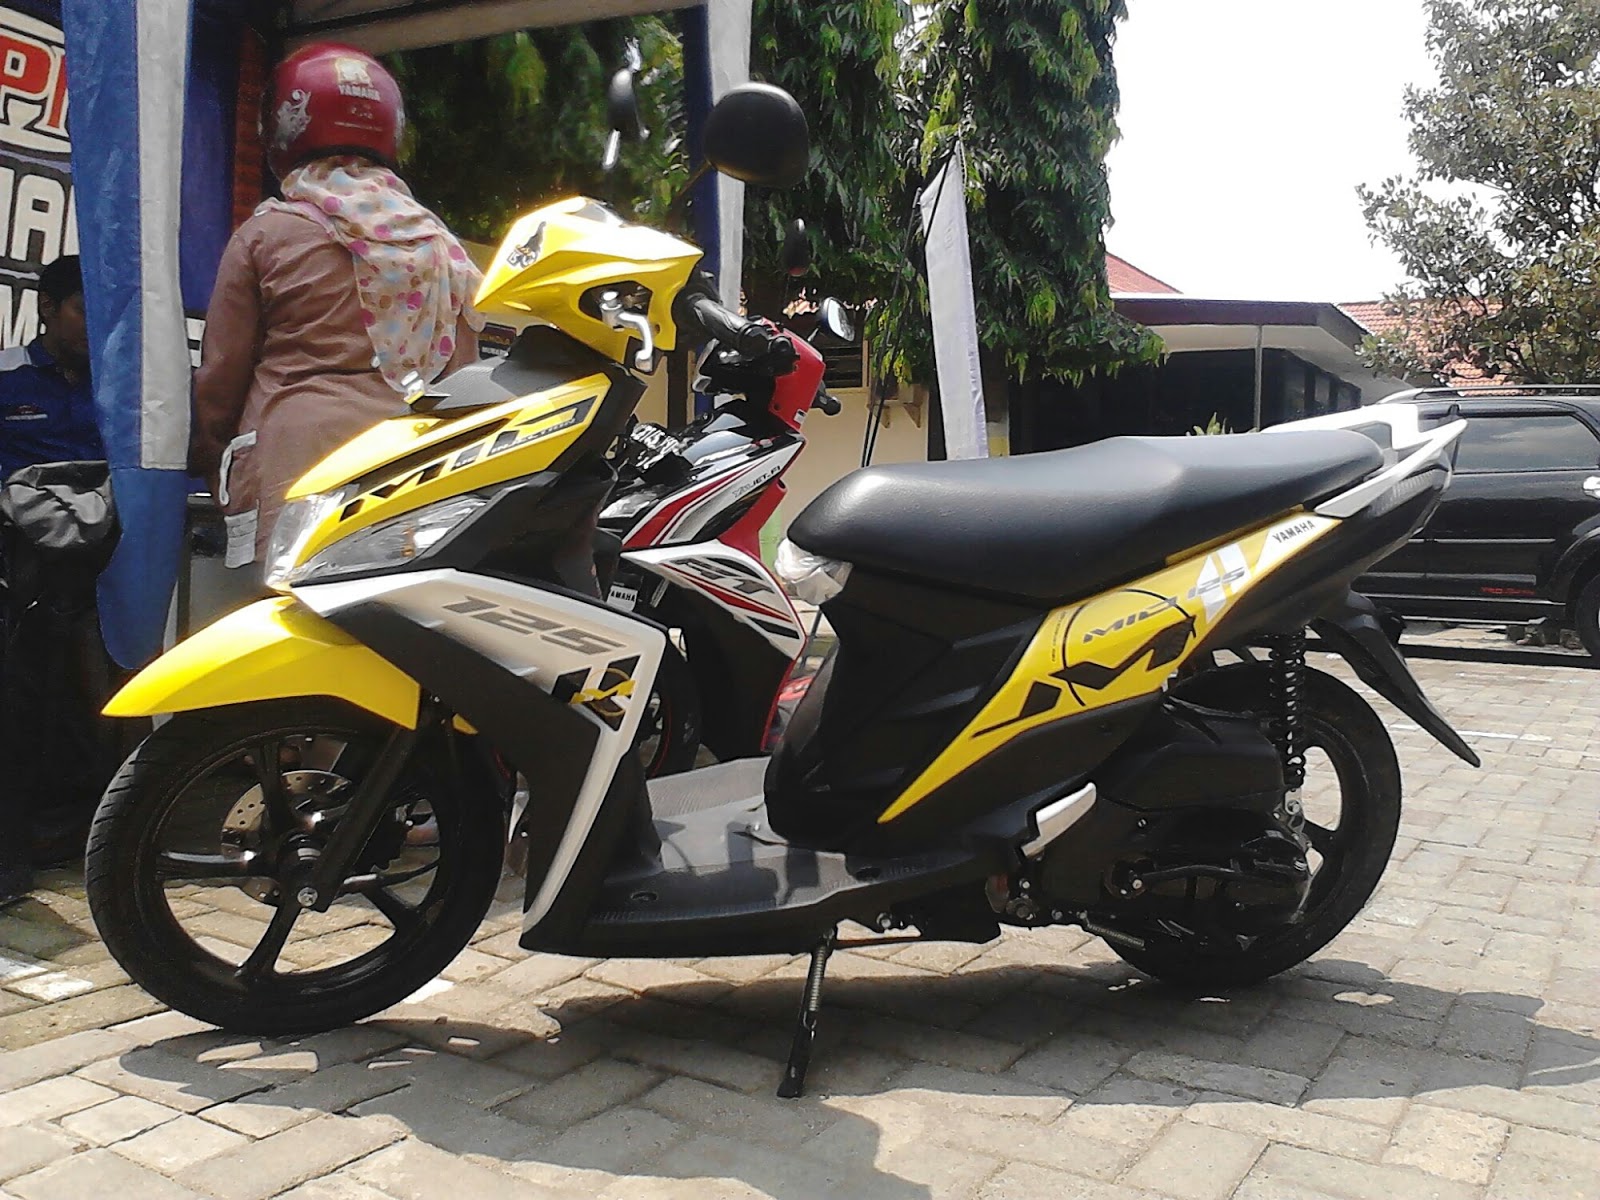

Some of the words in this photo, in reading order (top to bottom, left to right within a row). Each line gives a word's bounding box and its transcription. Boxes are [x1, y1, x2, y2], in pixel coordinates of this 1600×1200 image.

[1272, 520, 1315, 543] YAMAHA
[1187, 567, 1245, 600] 125
[442, 594, 627, 655] 125
